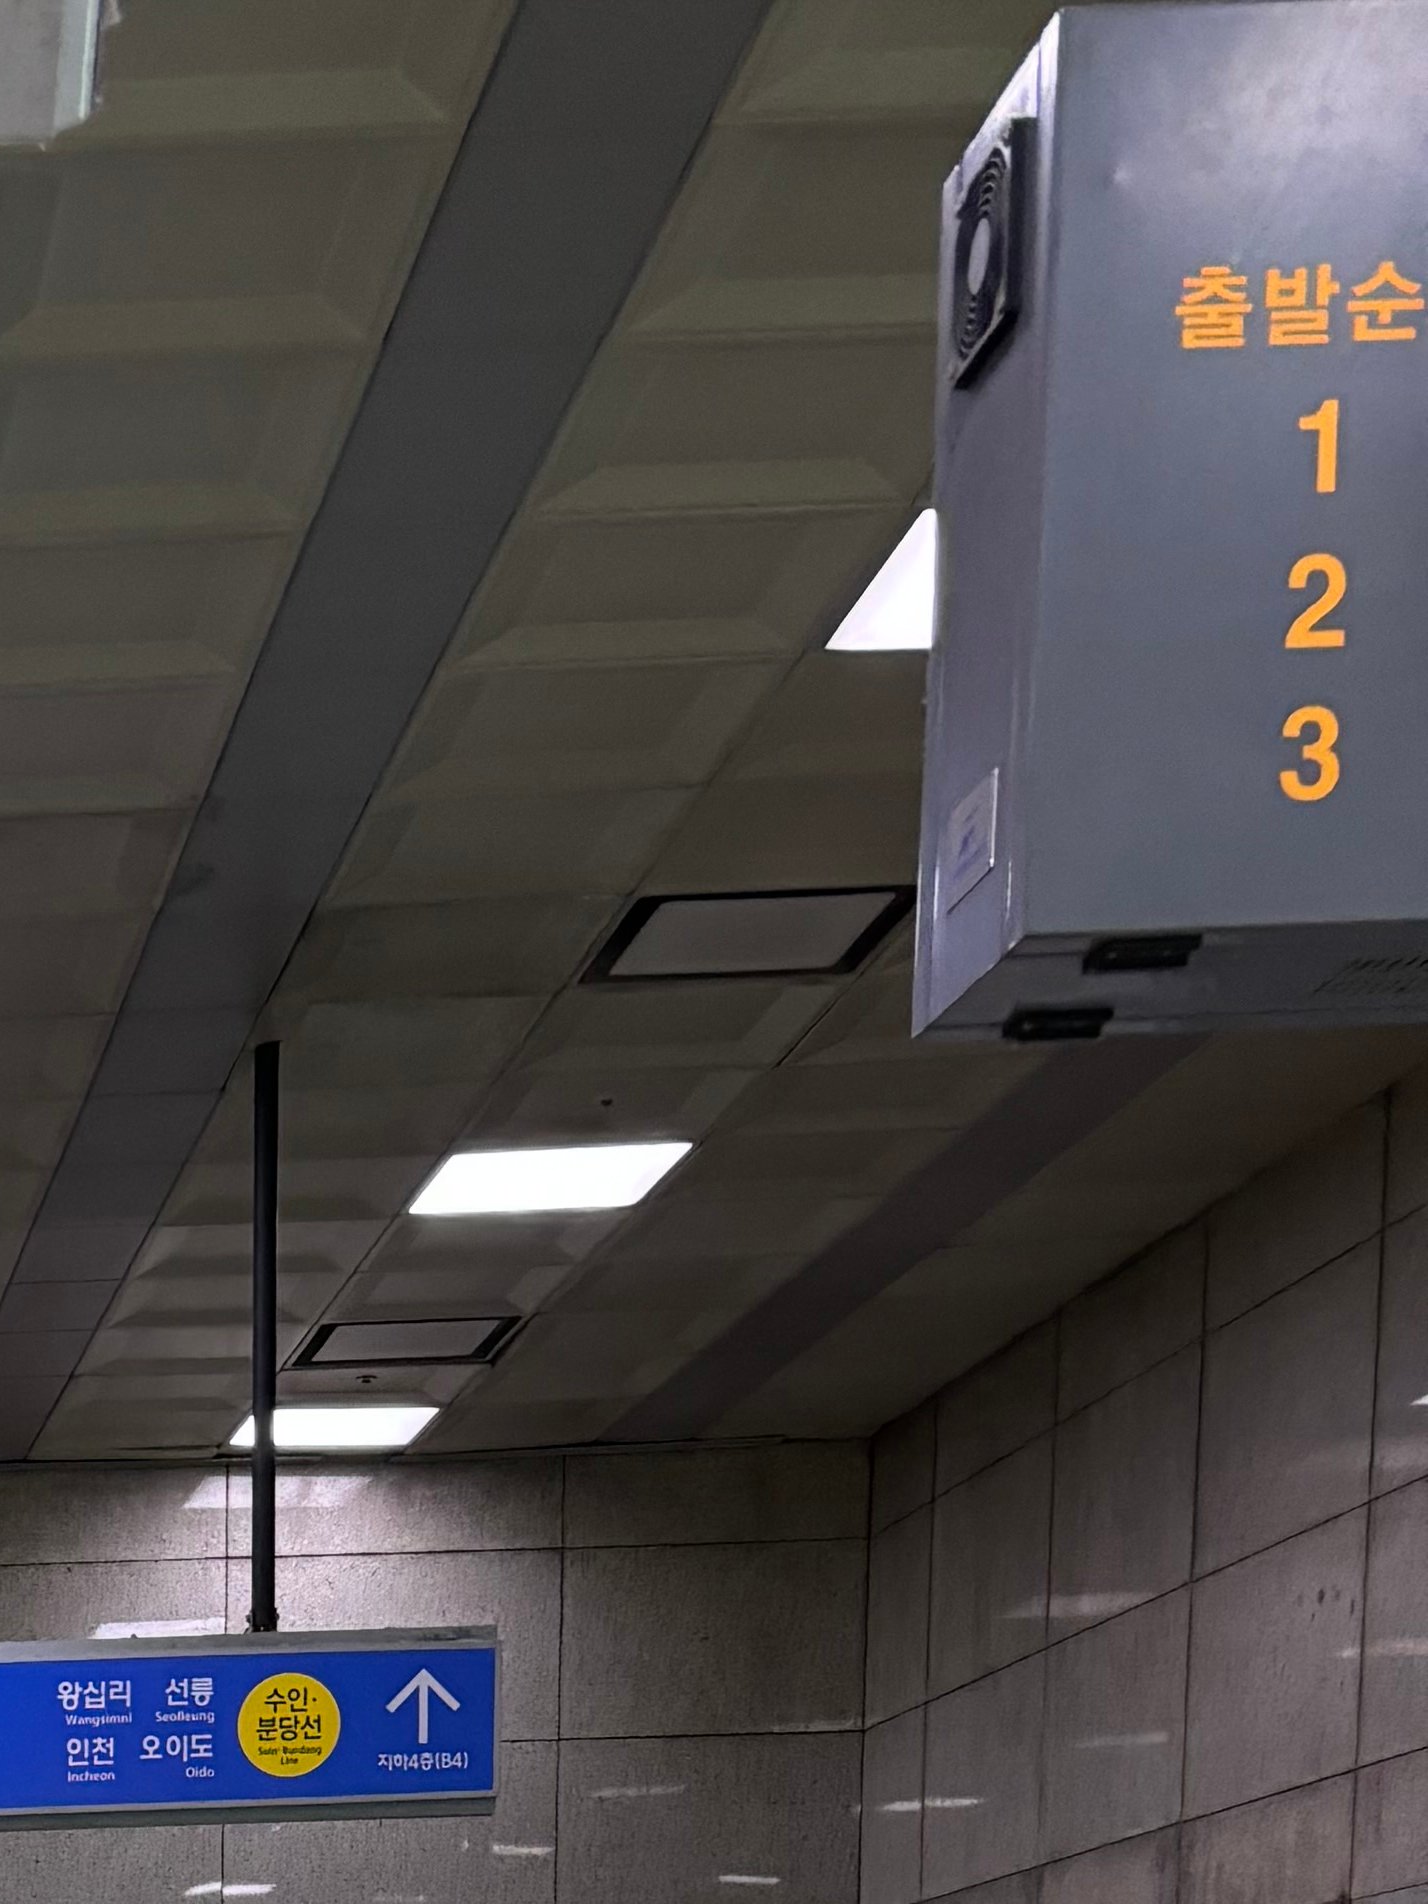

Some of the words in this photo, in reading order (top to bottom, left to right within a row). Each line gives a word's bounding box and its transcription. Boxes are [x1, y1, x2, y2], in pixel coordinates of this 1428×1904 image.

[1174, 260, 1428, 351] 출발순
[1298, 398, 1341, 494] 1
[1284, 552, 1347, 650] 2
[1280, 704, 1341, 802] 3
[57, 1679, 132, 1711] 왕십리
[165, 1677, 215, 1707] 선릉
[65, 1712, 132, 1727] Wangsimni
[155, 1711, 215, 1724] Seolleung
[256, 1714, 322, 1742] 분당선
[66, 1737, 115, 1767] 인천
[139, 1734, 214, 1763] 오이도
[67, 1770, 116, 1782] Incheon
[185, 1766, 215, 1778] Oido
